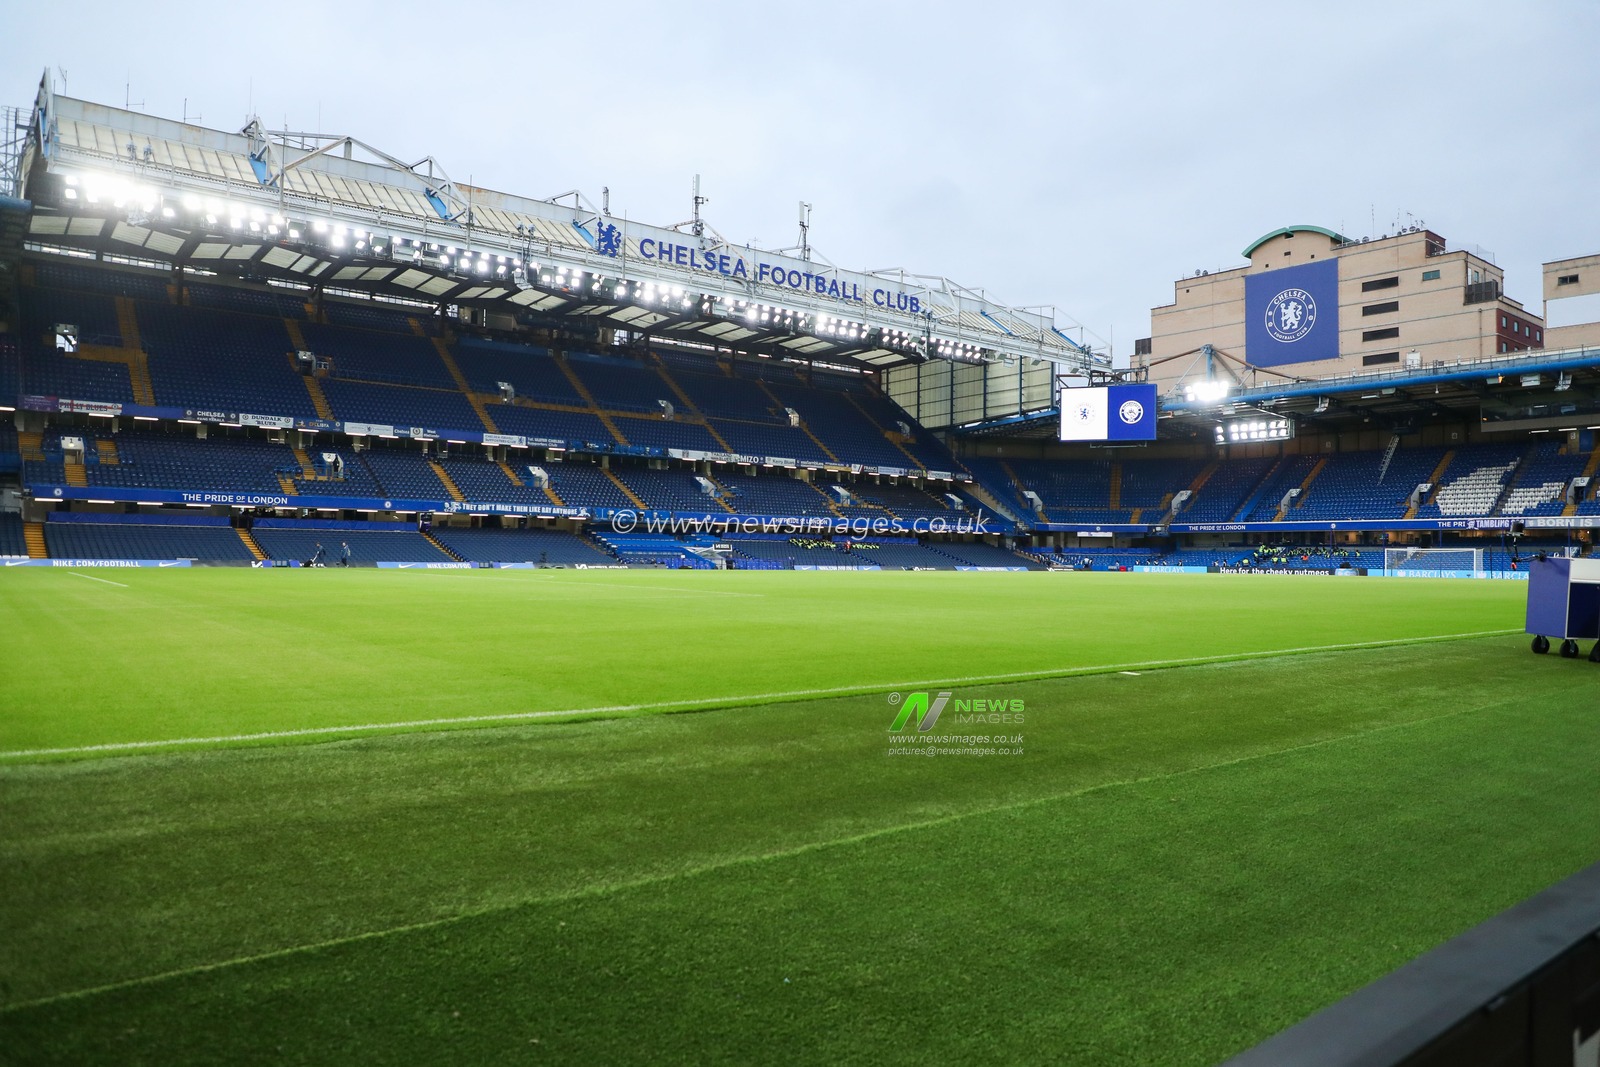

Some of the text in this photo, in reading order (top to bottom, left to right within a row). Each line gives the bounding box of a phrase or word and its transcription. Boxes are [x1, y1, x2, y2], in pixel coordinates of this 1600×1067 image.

[639, 238, 920, 314] CHELSEA FOOTBALL CLUB
[1274, 291, 1306, 304] CHELSEA
[1274, 327, 1308, 340] FOOTBALL CLUB
[740, 455, 759, 464] MIZO
[183, 493, 202, 501] THE
[204, 494, 234, 502] PRIDE
[248, 496, 288, 505] LONDON
[462, 502, 476, 511] THEY
